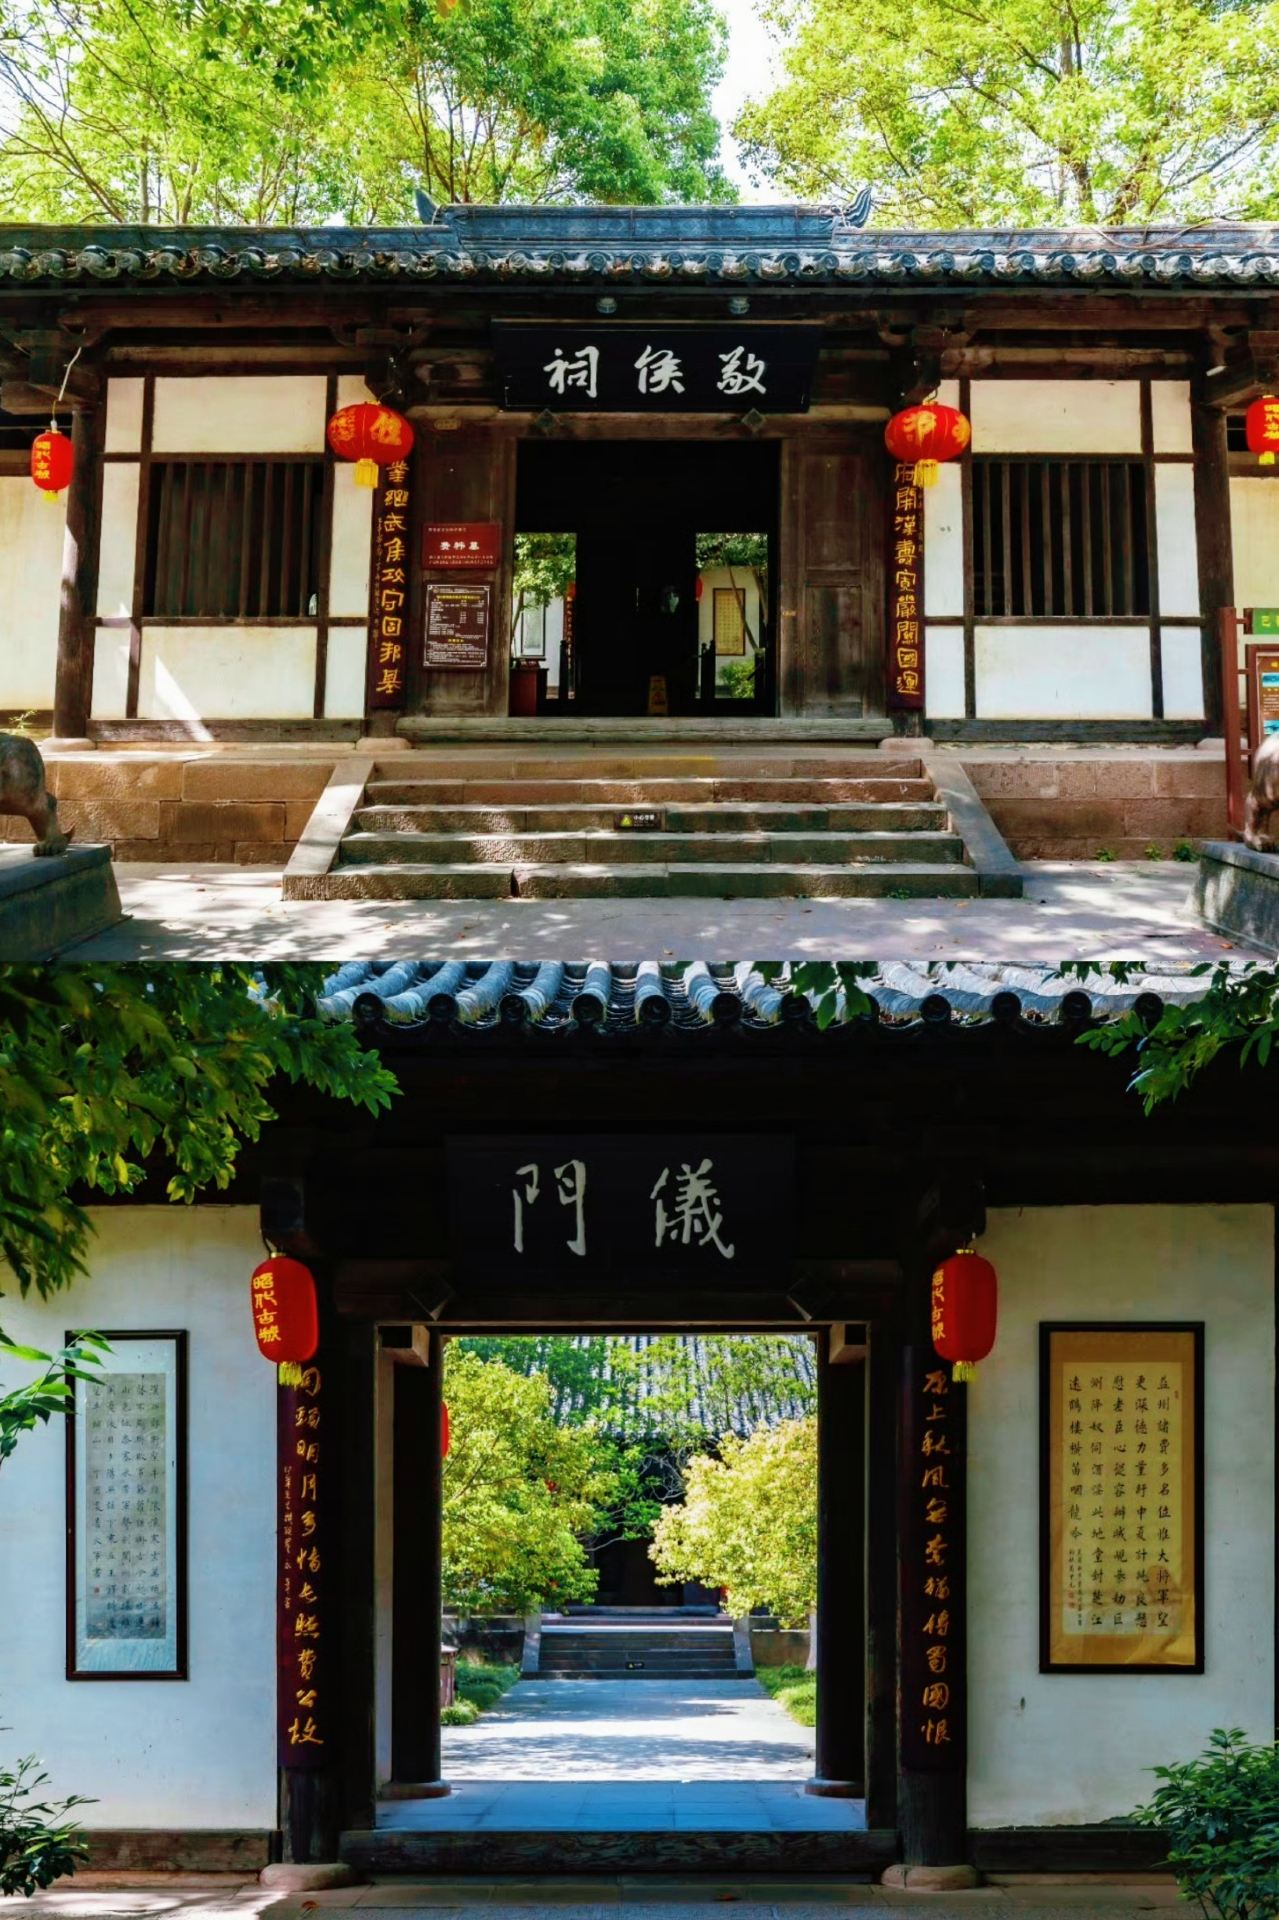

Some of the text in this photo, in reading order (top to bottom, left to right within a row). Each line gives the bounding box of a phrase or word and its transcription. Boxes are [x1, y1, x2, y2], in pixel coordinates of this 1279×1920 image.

[512, 1158, 735, 1259] 儀門
[253, 1272, 282, 1344] 昭化古城
